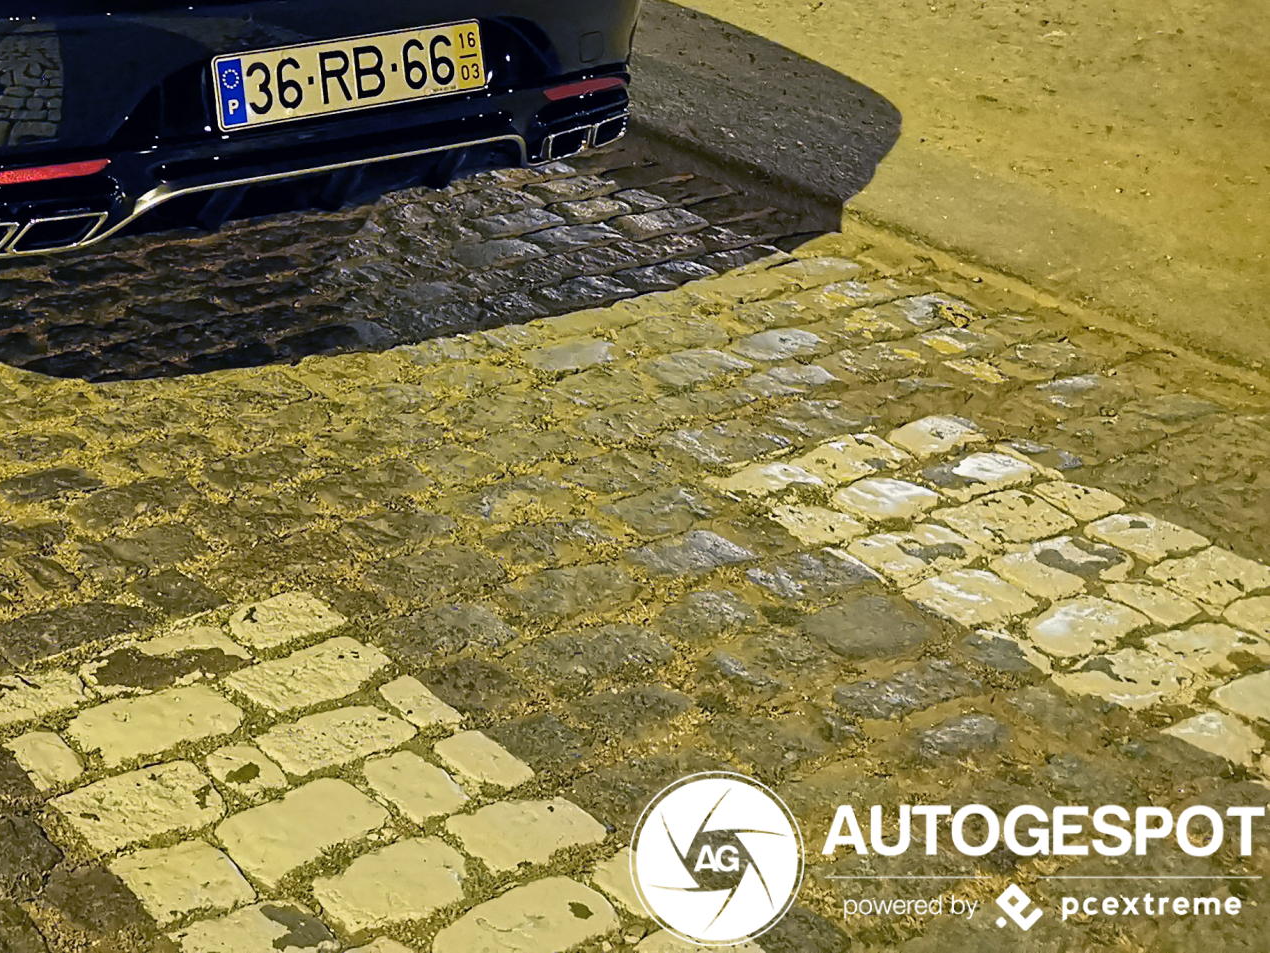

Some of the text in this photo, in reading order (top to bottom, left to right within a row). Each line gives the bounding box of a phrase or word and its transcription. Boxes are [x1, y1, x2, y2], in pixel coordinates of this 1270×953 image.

[459, 31, 477, 49] 16
[461, 63, 480, 81] 03
[228, 99, 240, 115] P
